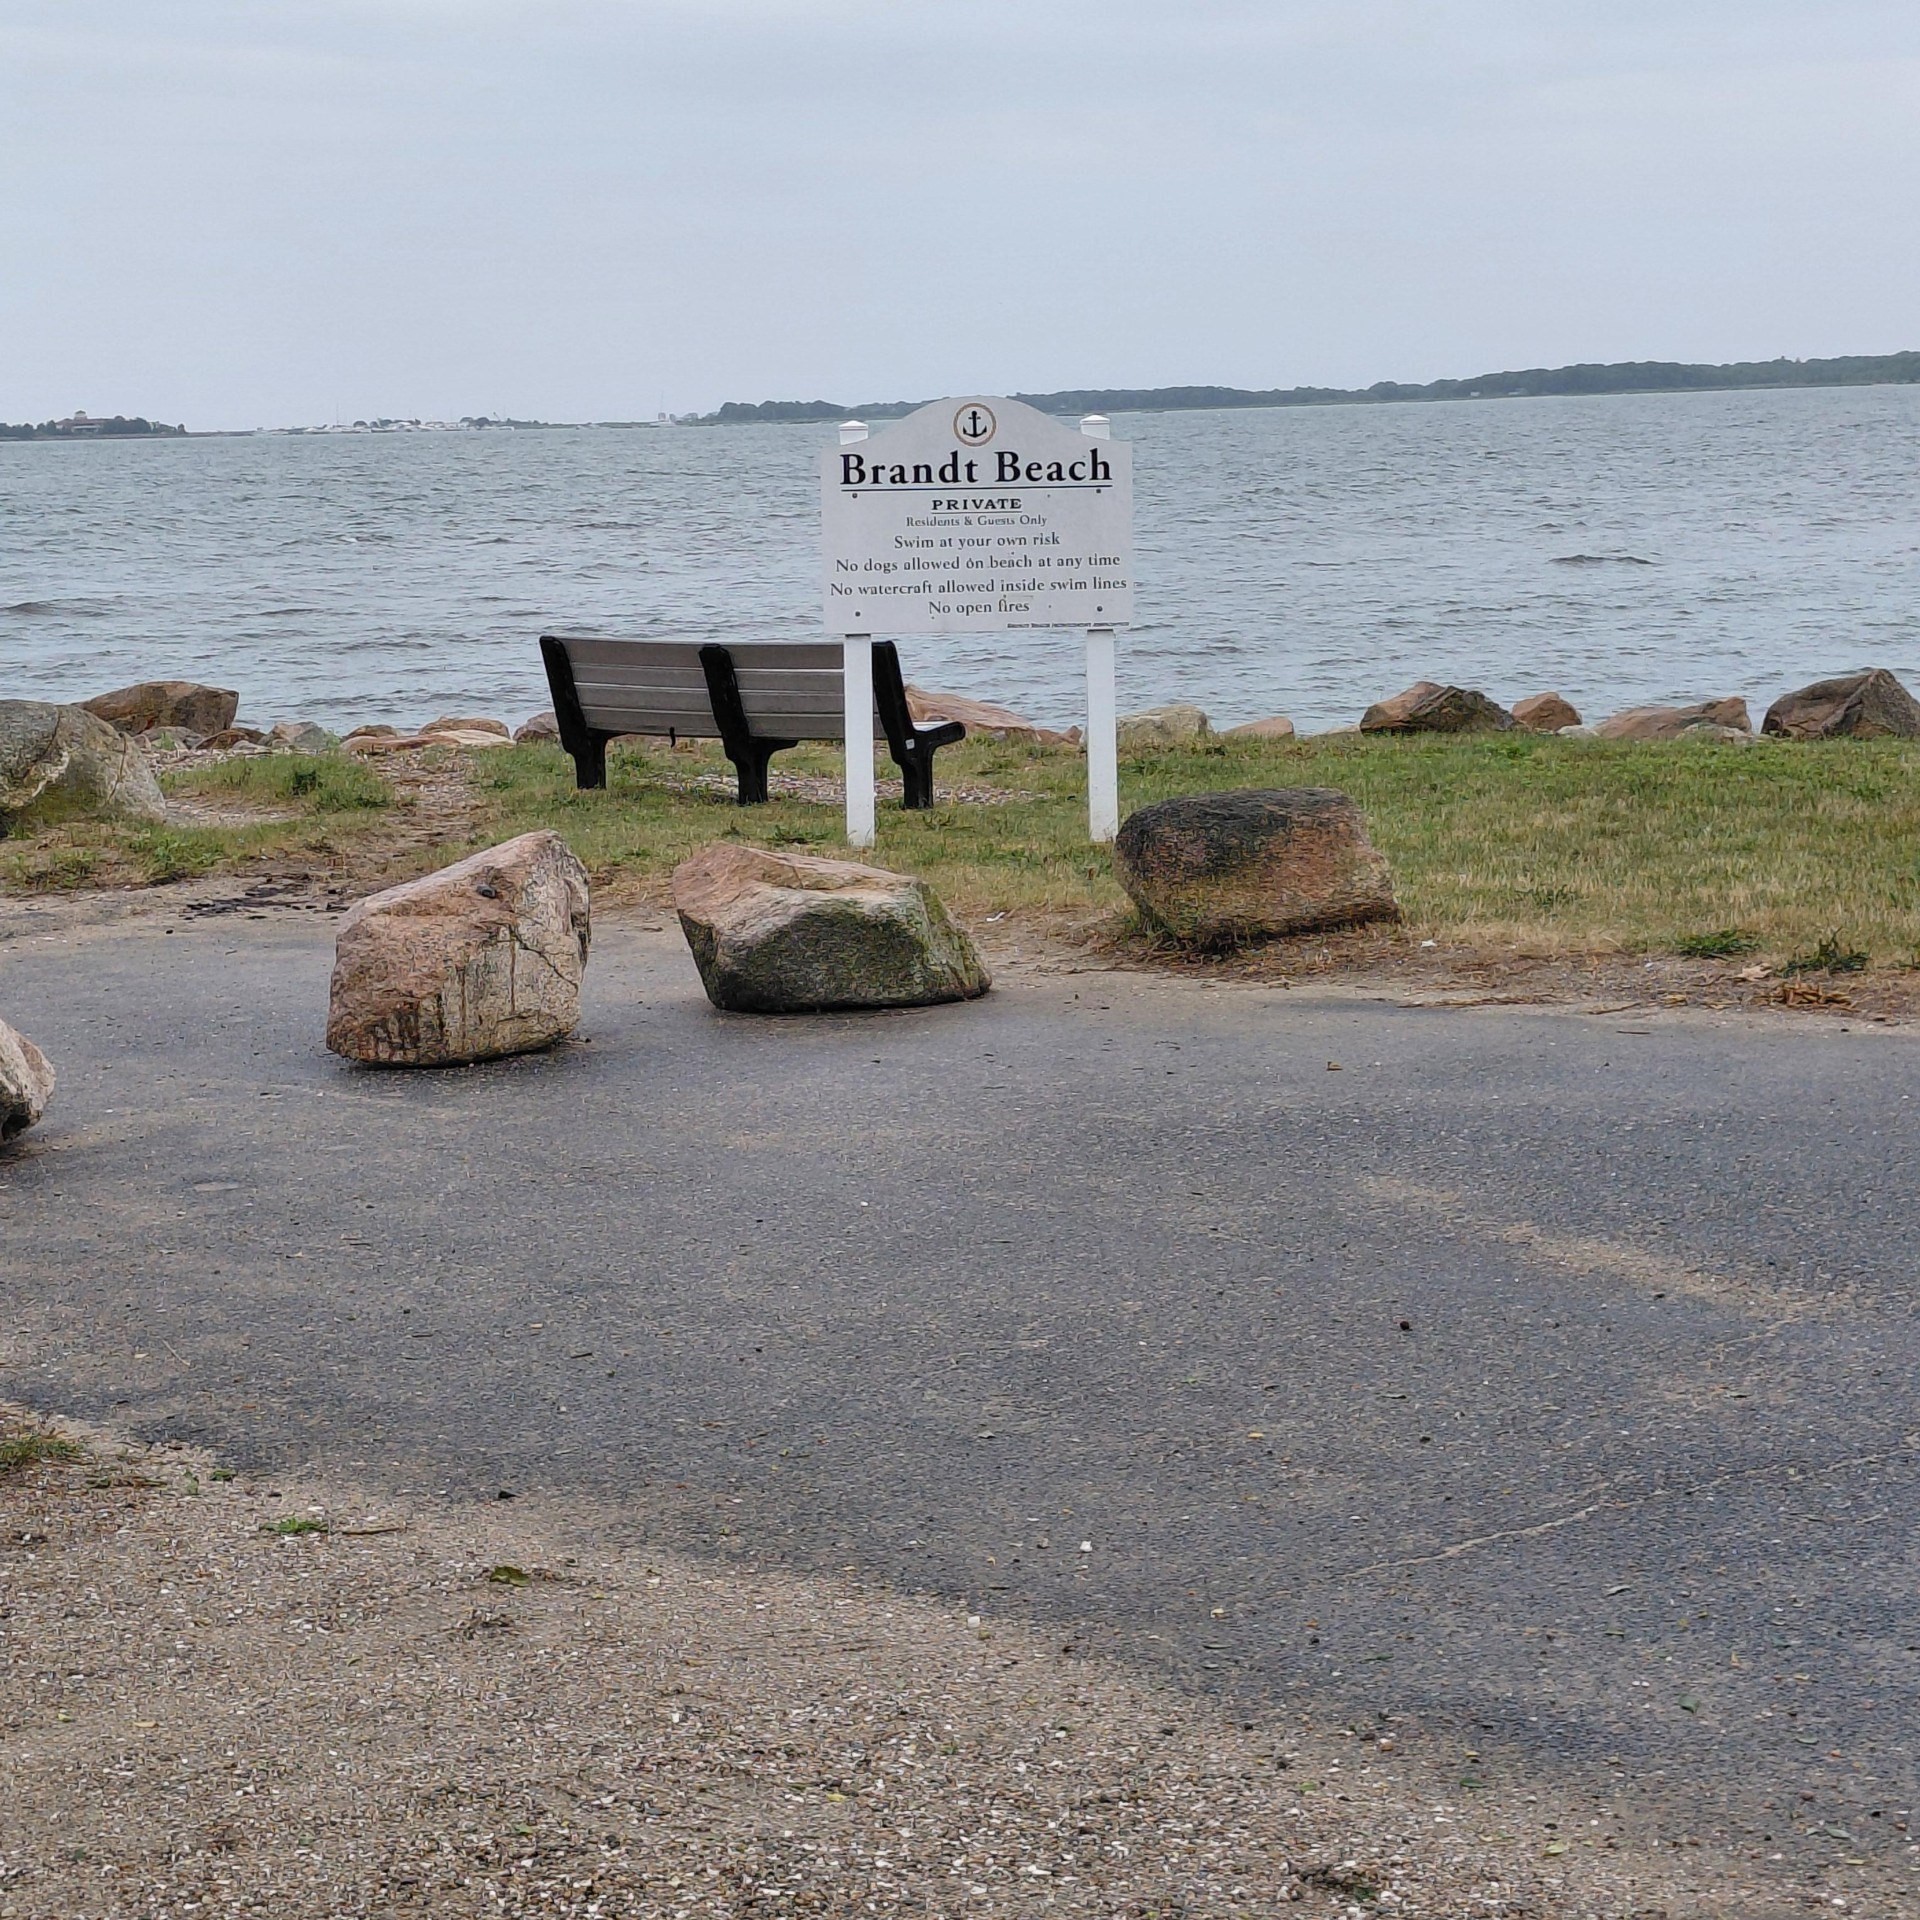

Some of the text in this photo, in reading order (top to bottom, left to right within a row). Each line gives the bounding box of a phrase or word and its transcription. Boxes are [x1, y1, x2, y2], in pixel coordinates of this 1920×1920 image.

[840, 448, 1112, 485] Brandt Beach
[932, 498, 1022, 511] PRIVATE
[906, 515, 1047, 527] Residents & Guests Only
[894, 533, 1060, 550] Swim at your own risk
[836, 553, 1120, 574] No dogs allowed on beach at any time
[830, 577, 1127, 595] No watercraft allowed inside swim lines
[929, 598, 1029, 617] No open fires
